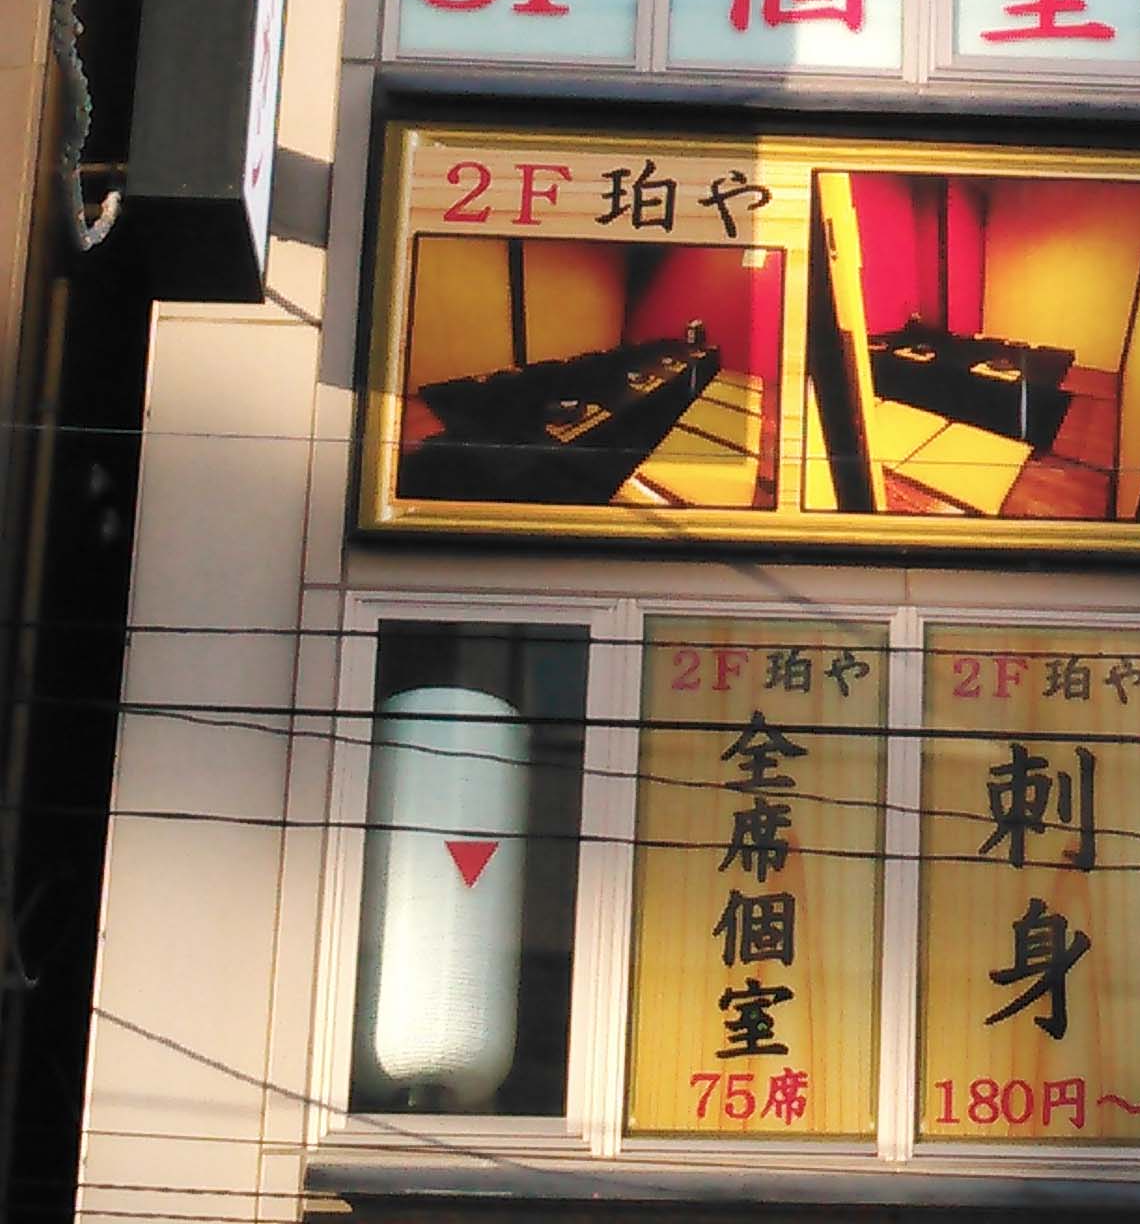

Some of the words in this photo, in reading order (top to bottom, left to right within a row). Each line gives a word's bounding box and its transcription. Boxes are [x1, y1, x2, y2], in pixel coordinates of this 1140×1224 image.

[713, 710, 808, 1059] 全席個室
[978, 742, 1097, 1040] 刺身
[690, 1067, 810, 1126] 75席
